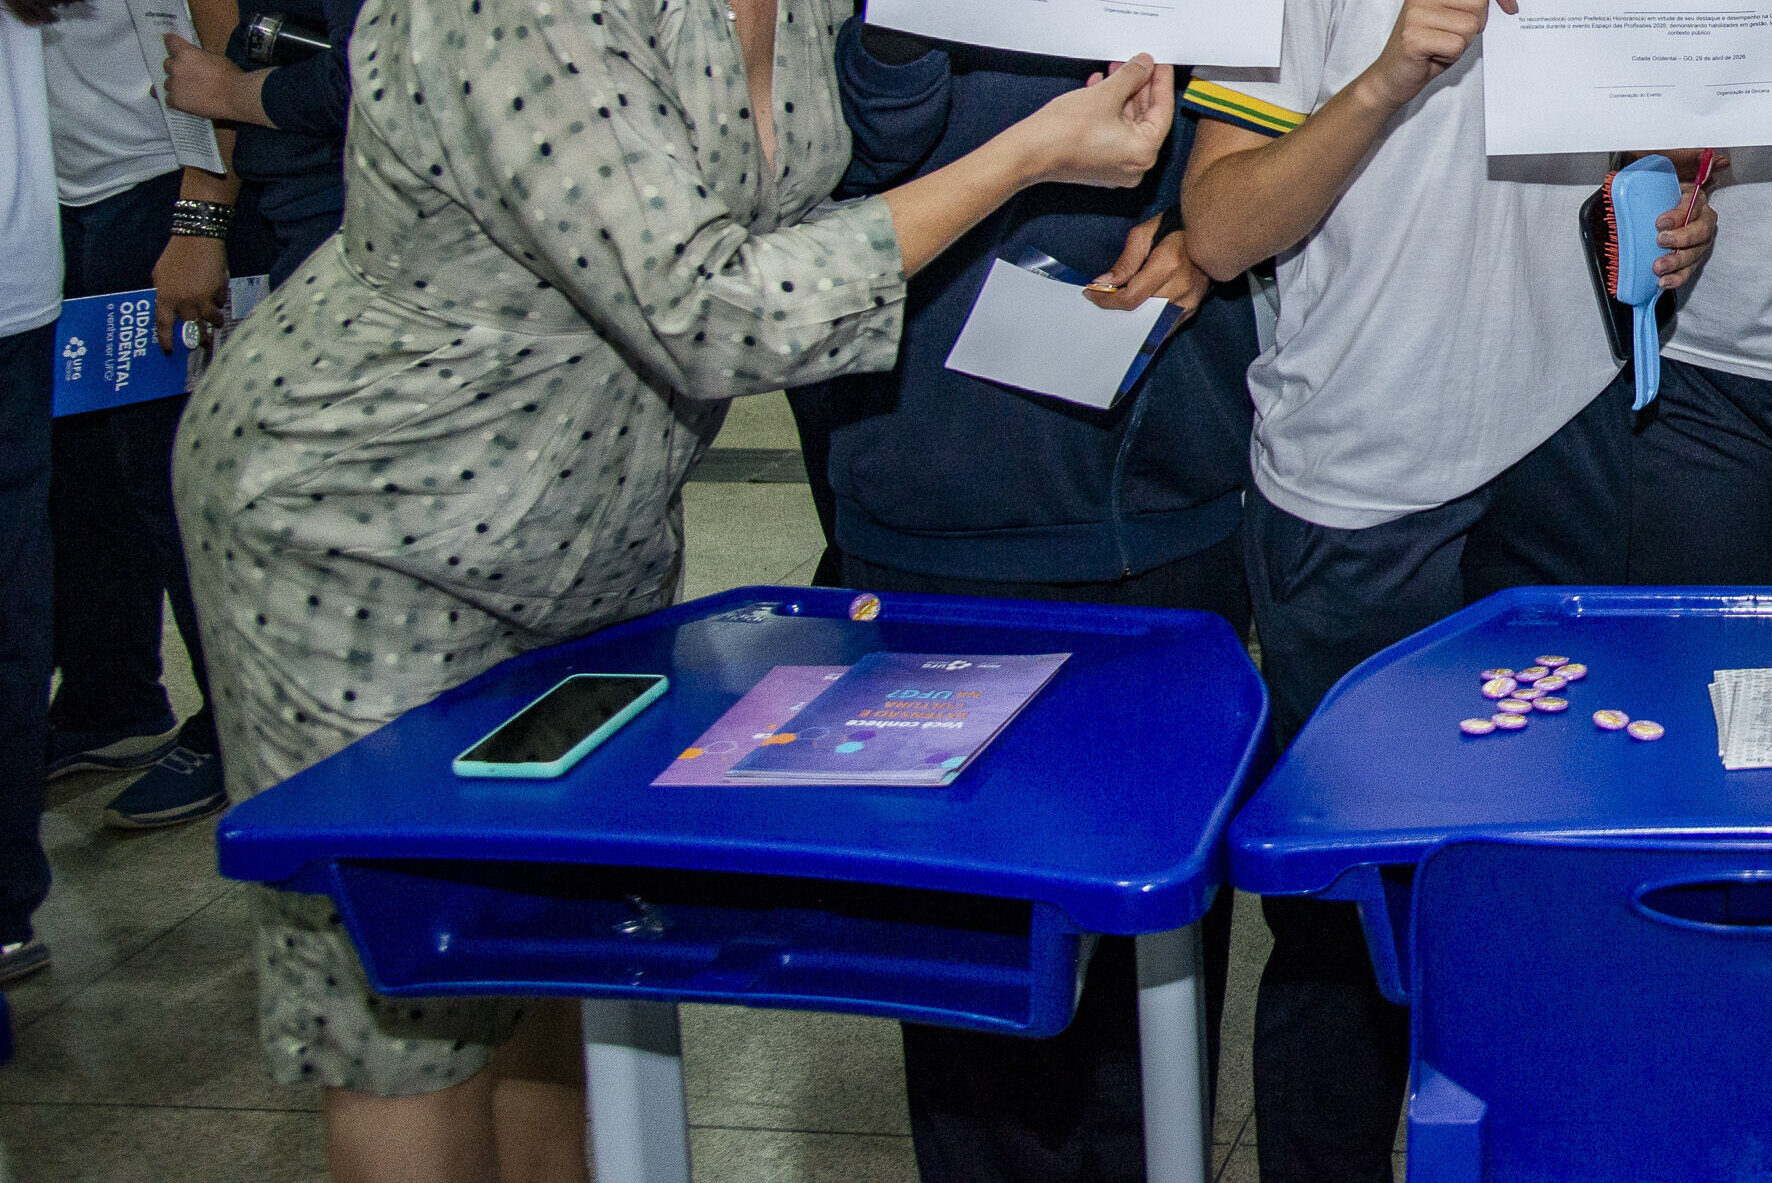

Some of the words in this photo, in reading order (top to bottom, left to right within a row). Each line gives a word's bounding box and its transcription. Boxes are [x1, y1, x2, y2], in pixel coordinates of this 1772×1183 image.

[133, 299, 150, 358] CIDADE
[115, 302, 134, 392] OCIDENTAL
[71, 359, 82, 380] UFG
[885, 689, 953, 700] UFG?
[845, 719, 920, 728] conhece
[921, 719, 964, 729] Você
